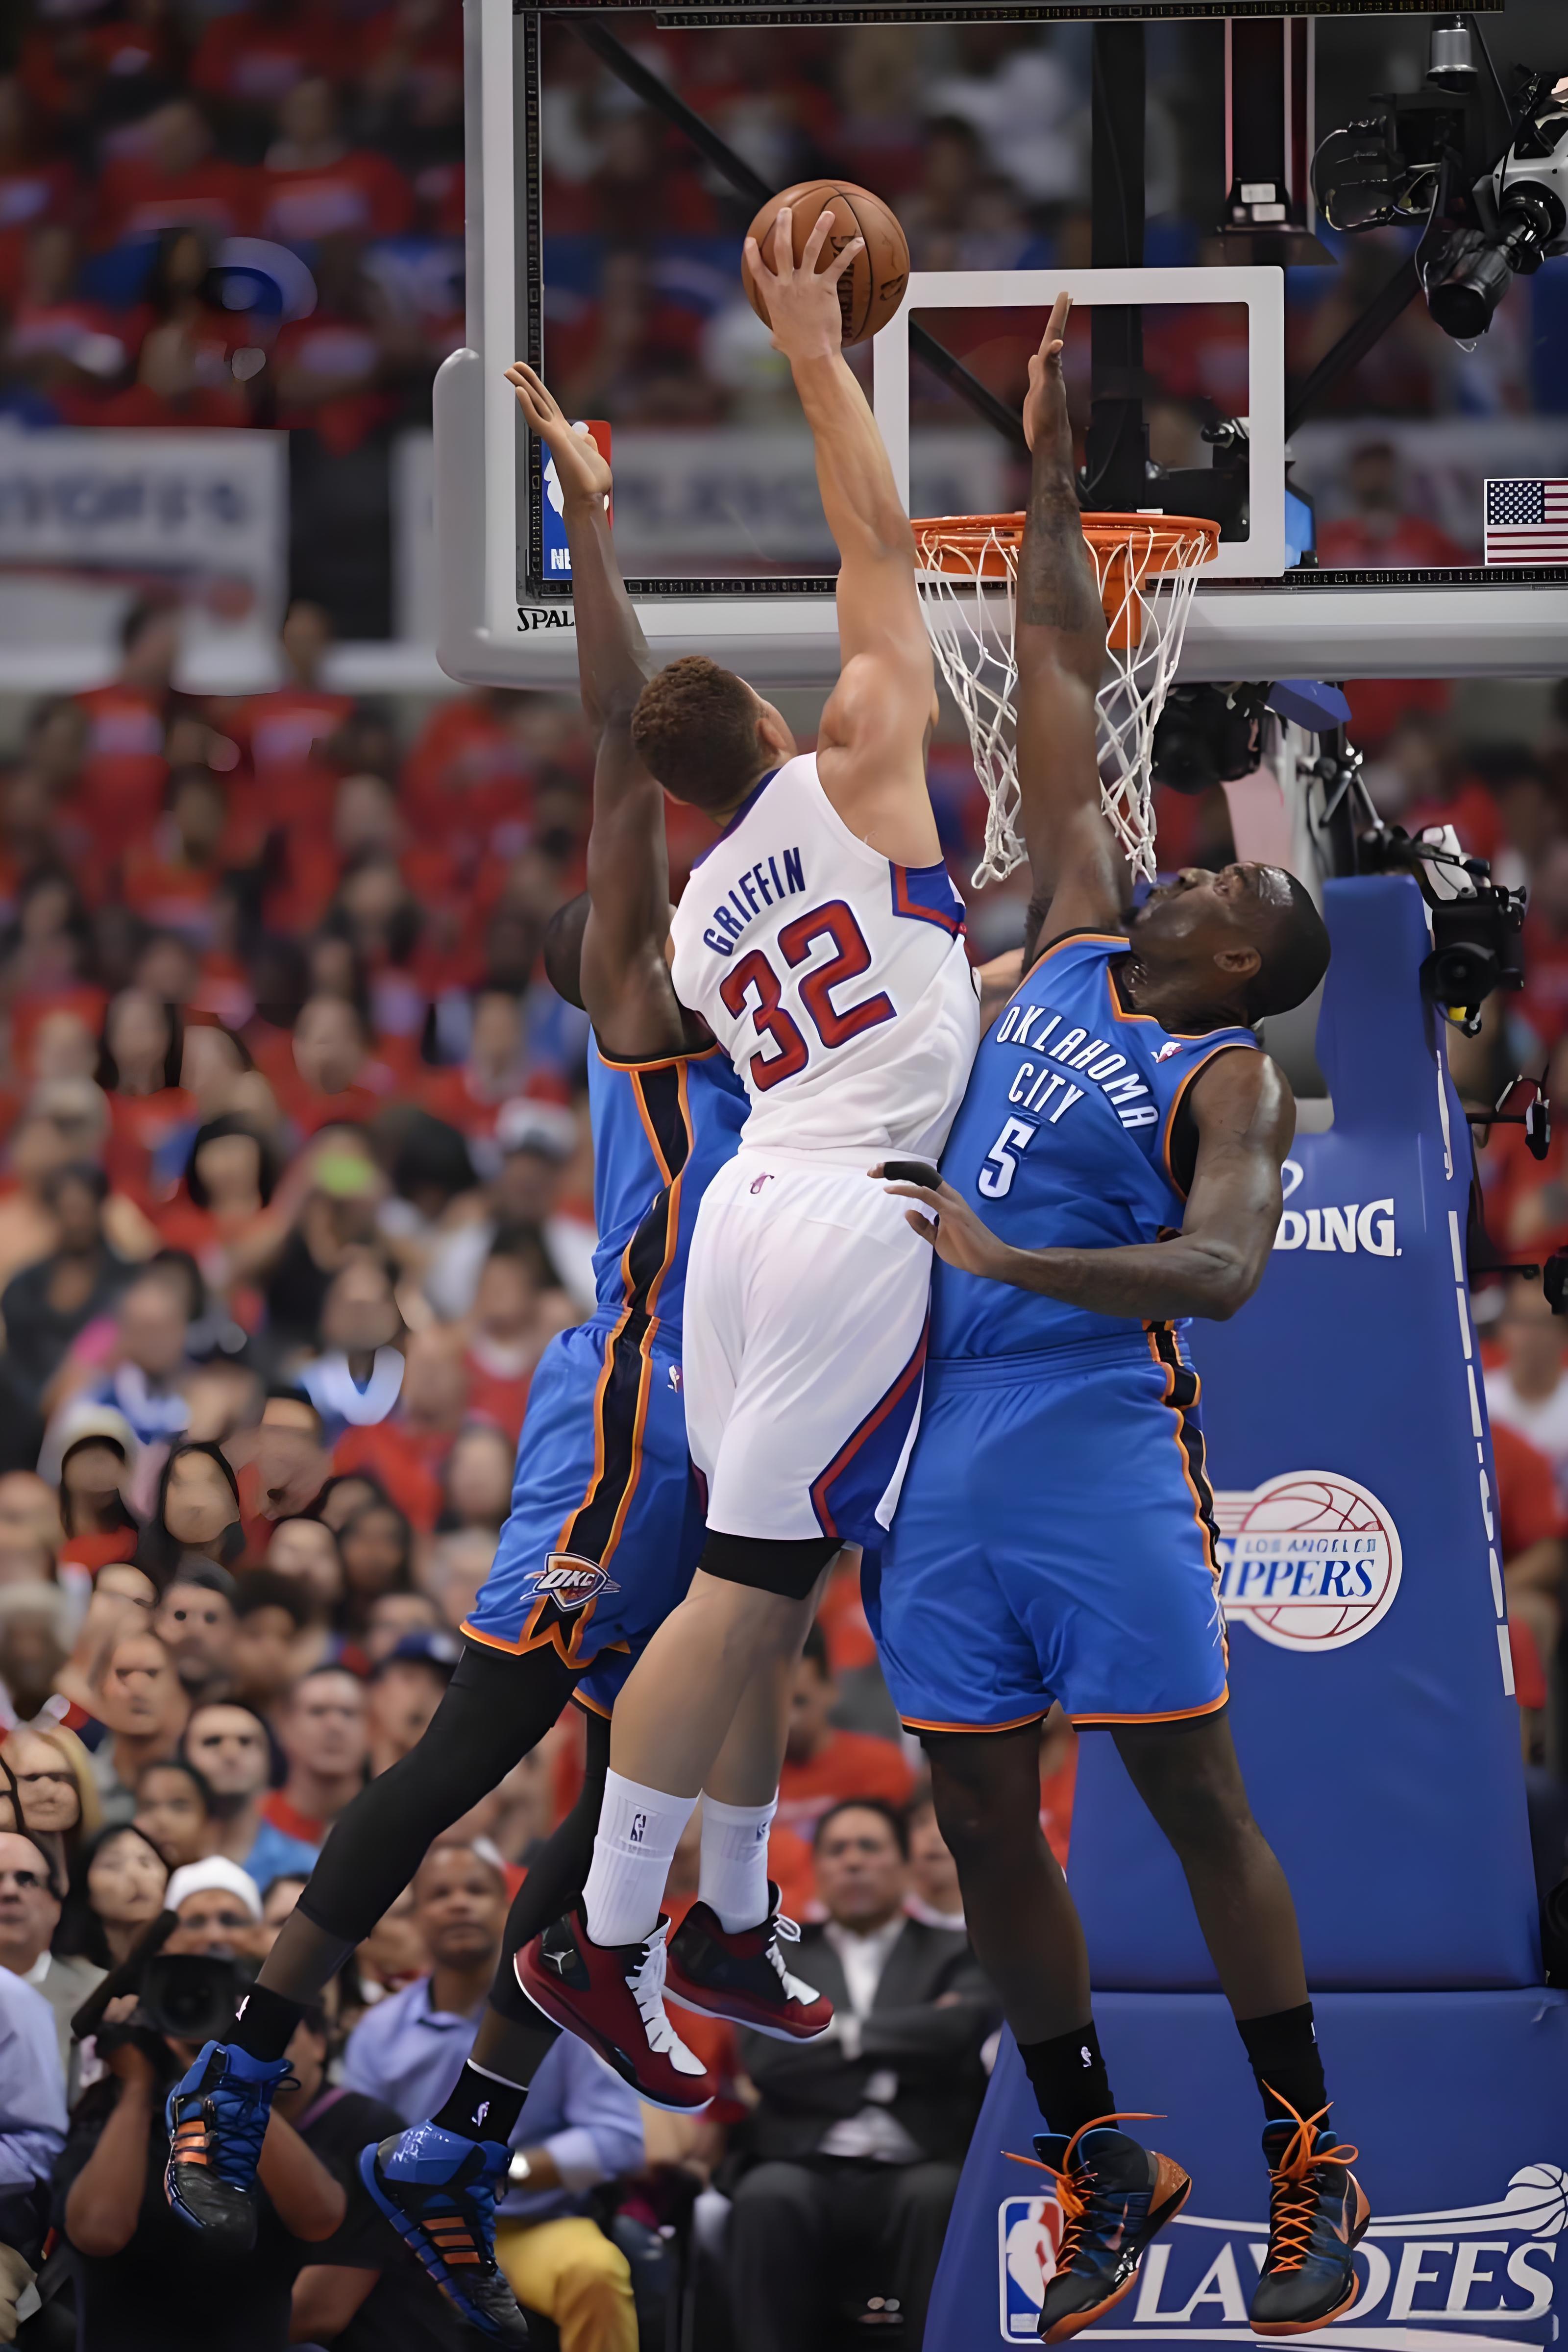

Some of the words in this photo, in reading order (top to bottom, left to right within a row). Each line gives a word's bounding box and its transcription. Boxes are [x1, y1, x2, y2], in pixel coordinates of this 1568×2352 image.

[517, 607, 575, 632] SPAL
[703, 847, 806, 956] GRIFFIN
[719, 899, 898, 1092] 32
[996, 1004, 1159, 1128] OKLAHOMA
[1008, 1062, 1085, 1124] CITY
[978, 1115, 1037, 1199] 5
[537, 1568, 596, 1590] OKC
[1218, 1559, 1375, 1597] IPPERS
[1132, 2241, 1557, 2323] LAOFFS
